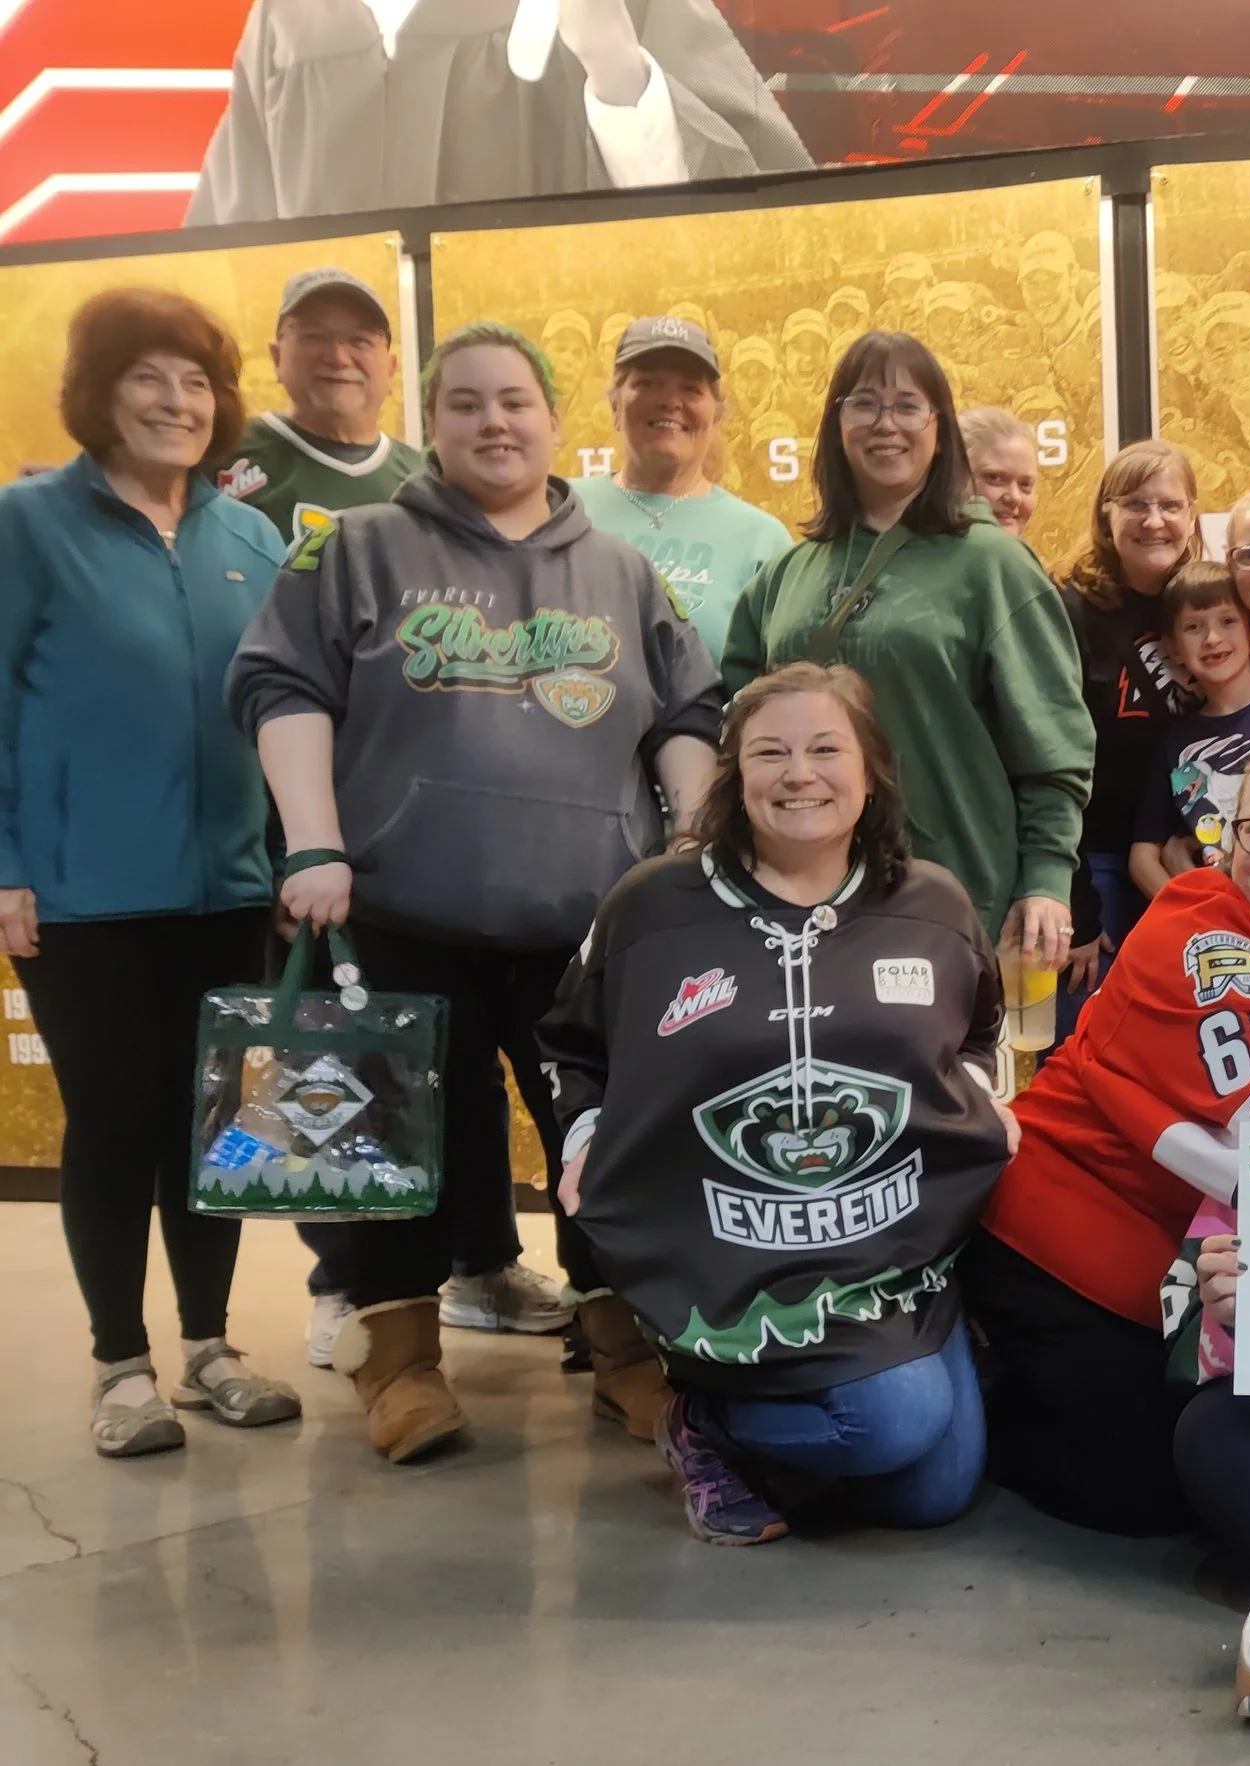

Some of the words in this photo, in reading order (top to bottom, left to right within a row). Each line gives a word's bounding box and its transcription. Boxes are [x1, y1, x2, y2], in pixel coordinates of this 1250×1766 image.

[400, 586, 497, 609] EVERETT
[397, 602, 612, 682] Silvertips
[877, 965, 928, 976] POLAR
[2, 988, 33, 1020] 19
[671, 974, 739, 1022] WHL
[767, 1005, 836, 1022] CCM
[8, 1032, 51, 1066] 199
[722, 1161, 918, 1246] EVERETT
